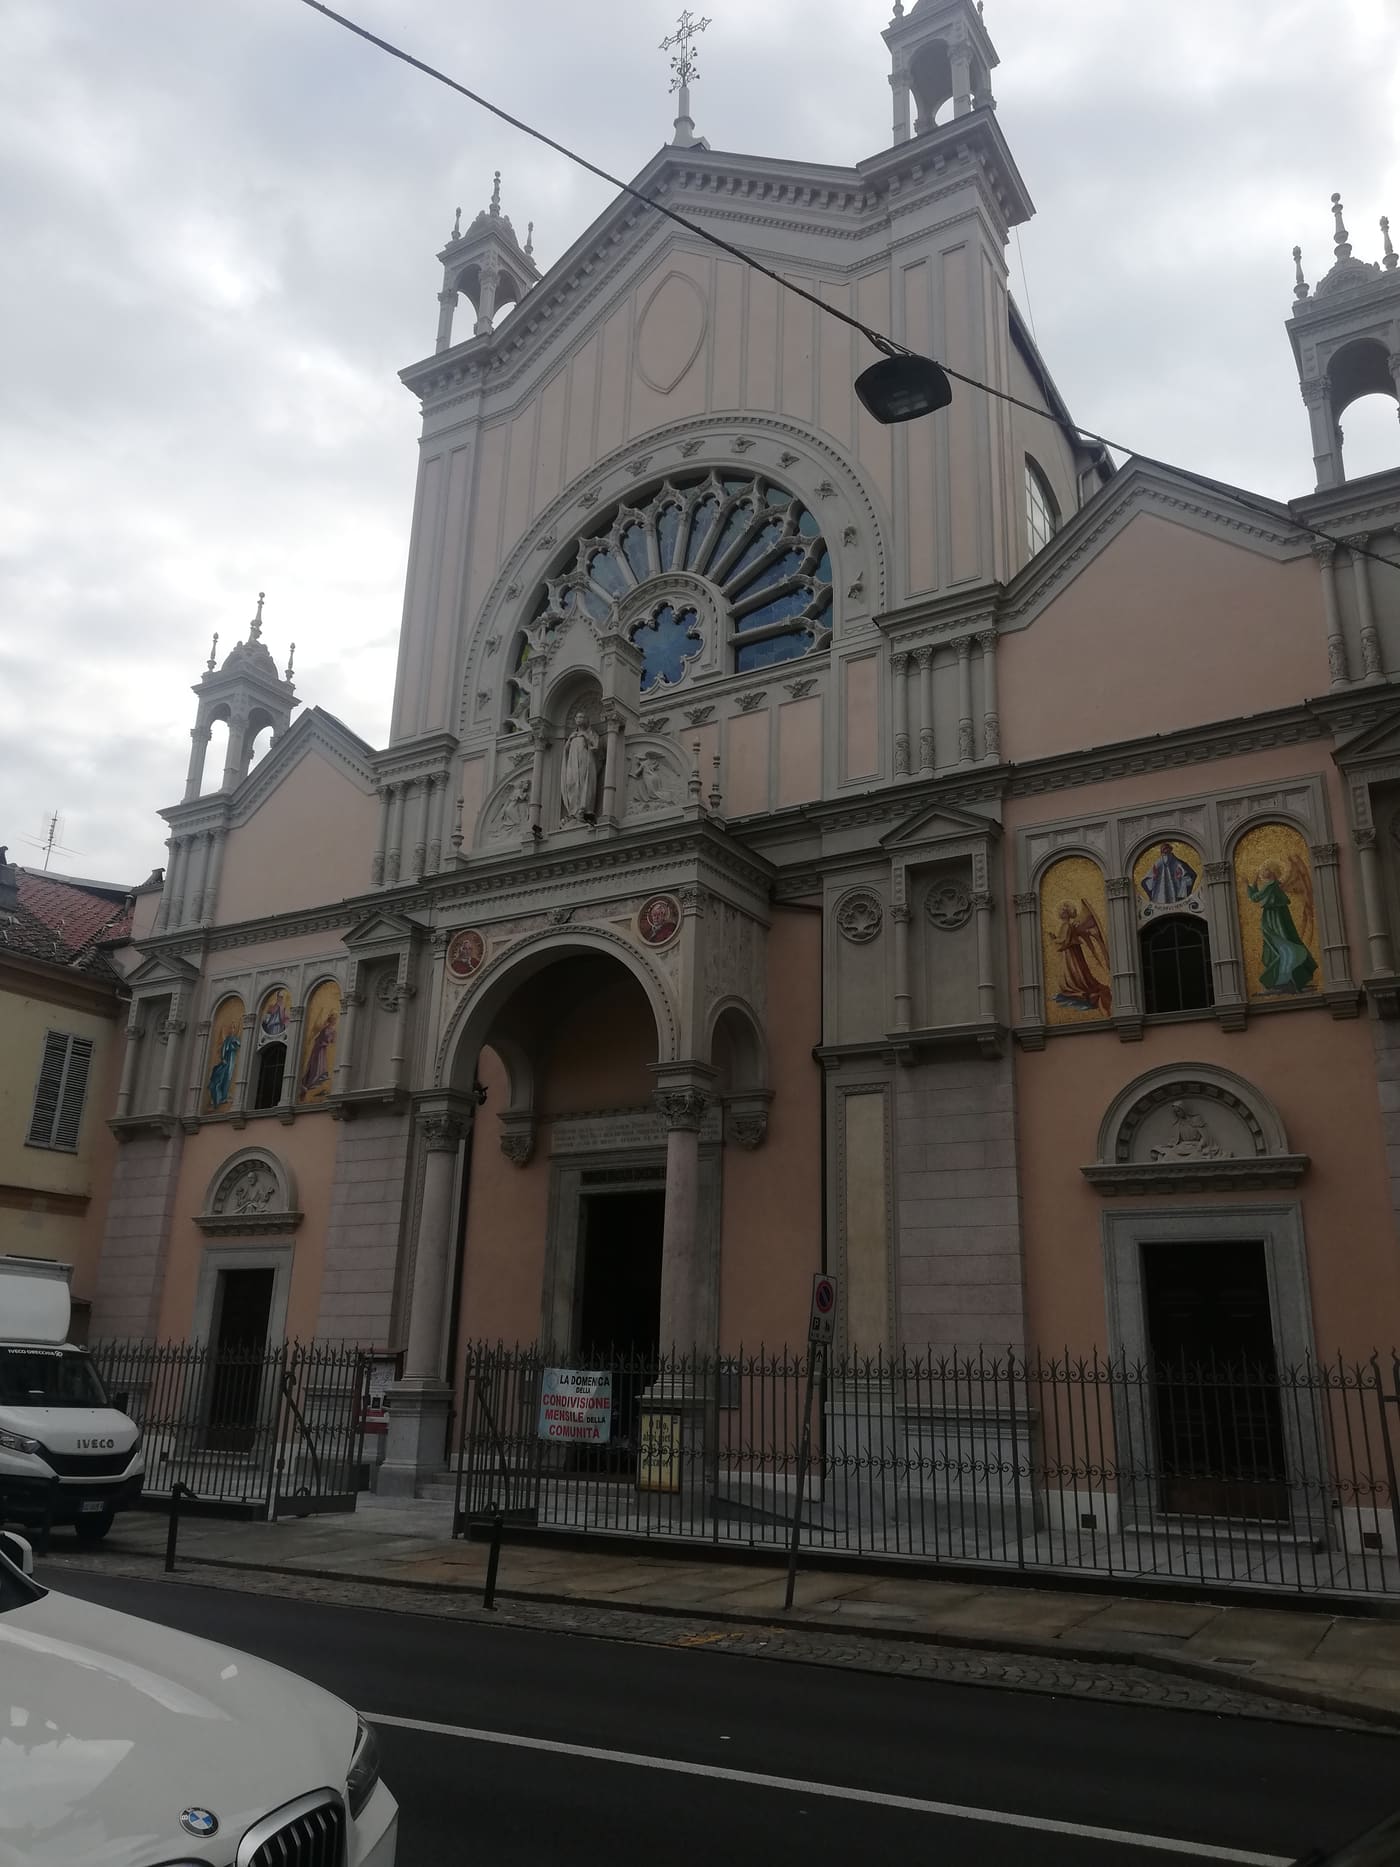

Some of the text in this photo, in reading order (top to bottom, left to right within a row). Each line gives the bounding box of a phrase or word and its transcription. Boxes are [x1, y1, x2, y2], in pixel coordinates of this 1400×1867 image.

[559, 1374, 610, 1386] LA DOMENCA
[543, 1393, 610, 1409] CONDIVISIONE
[545, 1409, 606, 1424] MENSILE DELLA
[76, 1439, 115, 1449] IVECO
